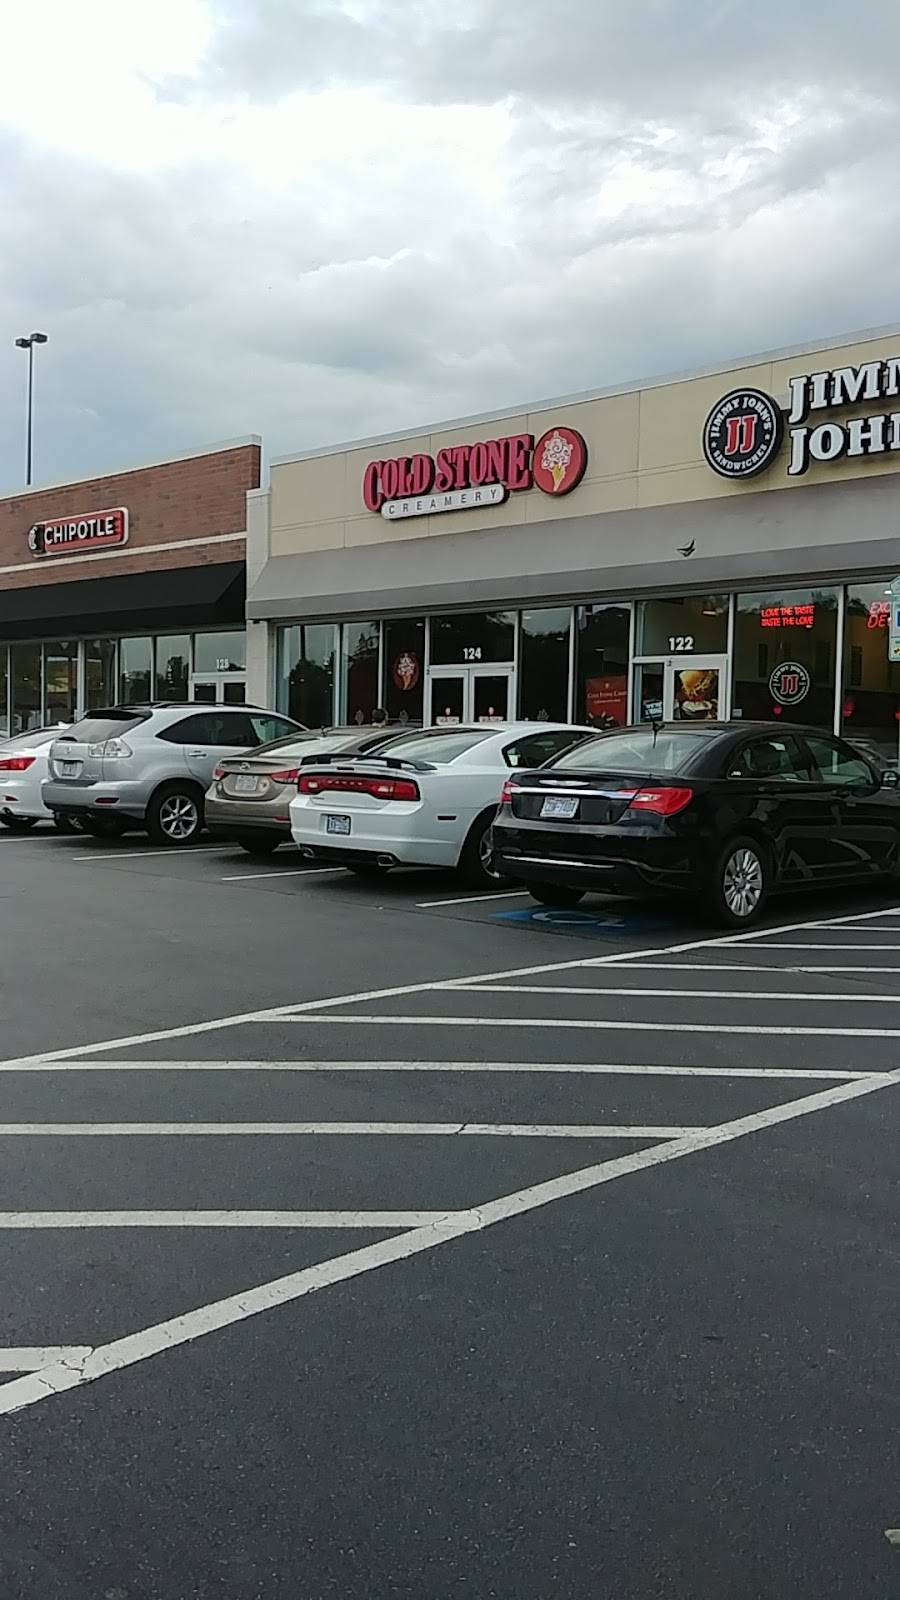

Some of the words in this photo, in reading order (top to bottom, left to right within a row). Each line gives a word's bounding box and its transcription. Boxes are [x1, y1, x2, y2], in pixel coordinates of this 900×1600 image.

[788, 357, 900, 424] JIM
[710, 398, 740, 438] JIMMY
[742, 396, 772, 431] JOHN'S
[724, 414, 758, 456] JJ
[788, 413, 900, 475] JOH
[713, 443, 768, 470] SANDWICHES
[363, 453, 433, 512] COLD
[436, 434, 532, 491] STONE
[389, 489, 497, 514] CREAMERY
[44, 516, 114, 544] CHIPOTLE
[761, 607, 779, 617] LOVE
[780, 607, 793, 616] THE
[794, 605, 815, 615] TASTE
[761, 617, 781, 627] TASTE
[782, 616, 795, 626] THE
[796, 616, 814, 625] LOVE
[463, 647, 482, 660] 124
[668, 636, 694, 651] 122
